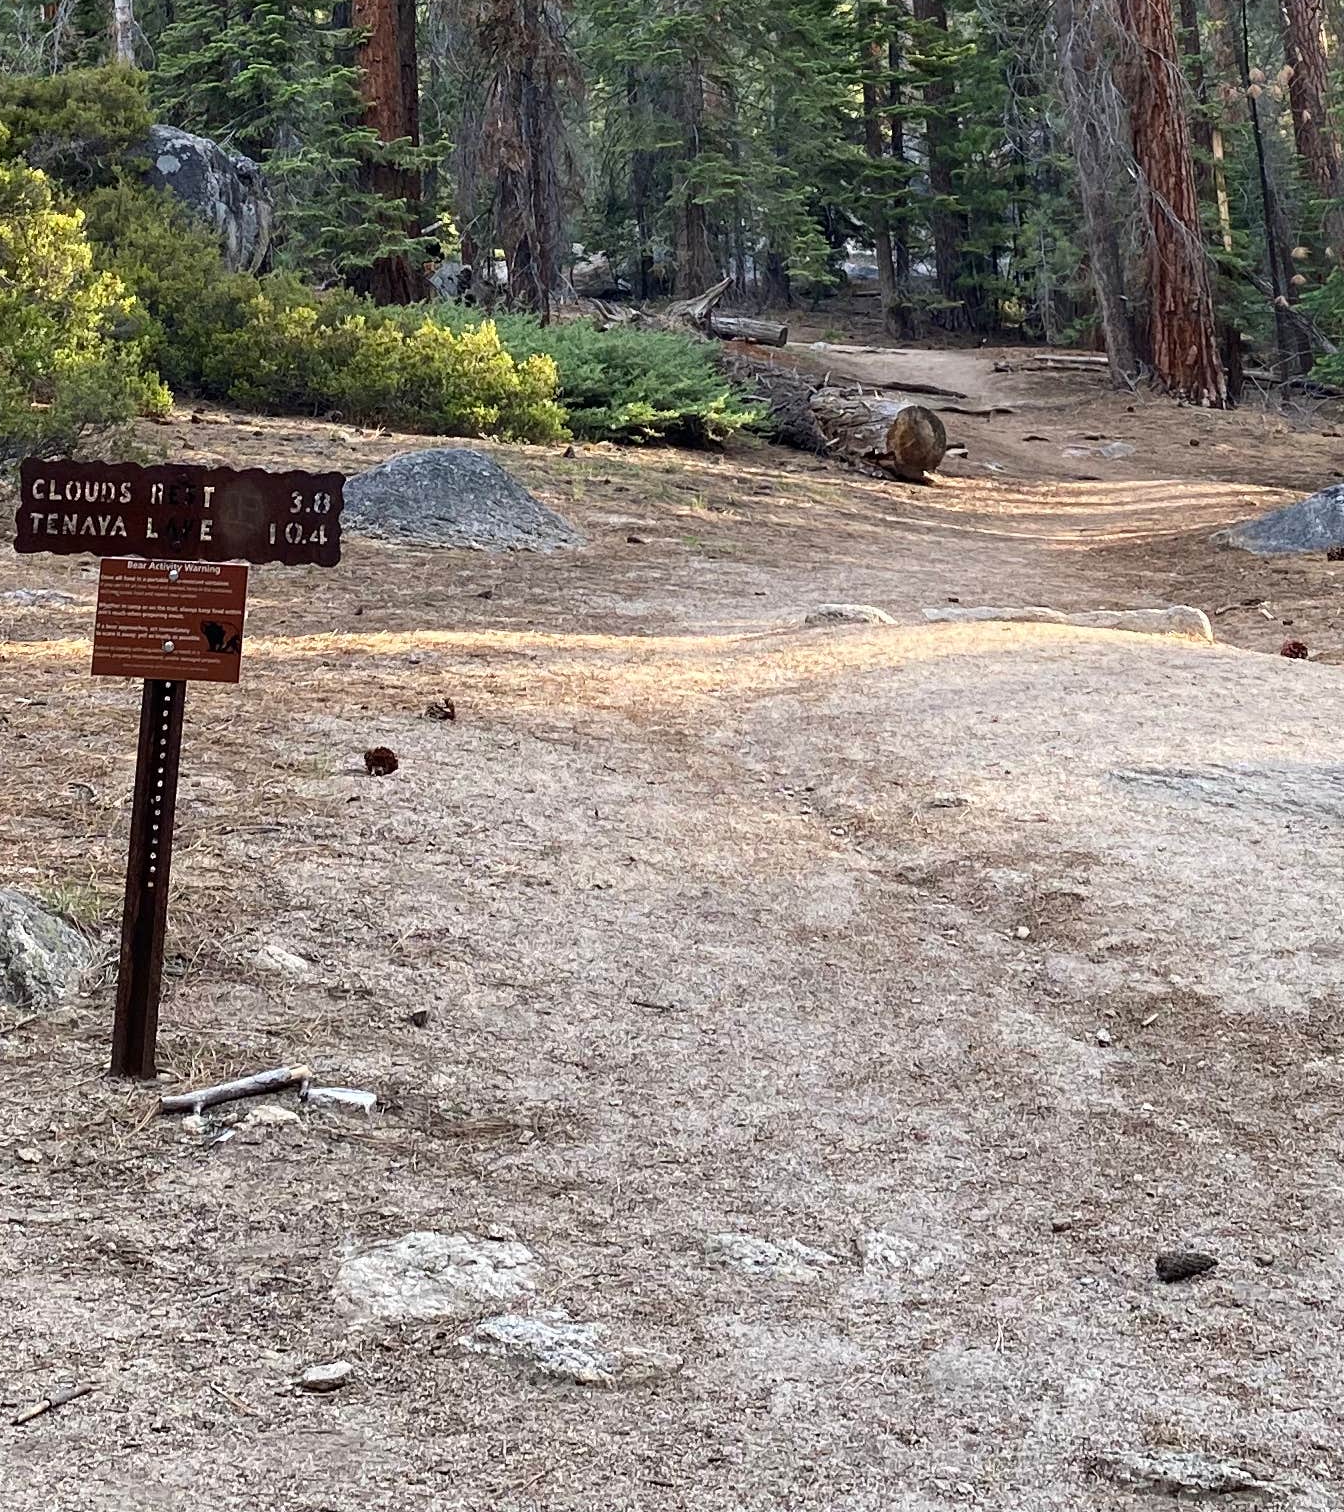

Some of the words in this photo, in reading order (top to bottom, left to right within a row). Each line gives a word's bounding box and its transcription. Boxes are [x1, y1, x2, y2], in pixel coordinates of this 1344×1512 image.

[32, 478, 132, 504] CLOUDS
[289, 491, 331, 514] 3.8
[30, 512, 127, 537] TENAYA
[269, 522, 328, 545] 10.4
[127, 561, 147, 569] Bear
[148, 561, 183, 573] Activity
[185, 563, 221, 575] Warning
